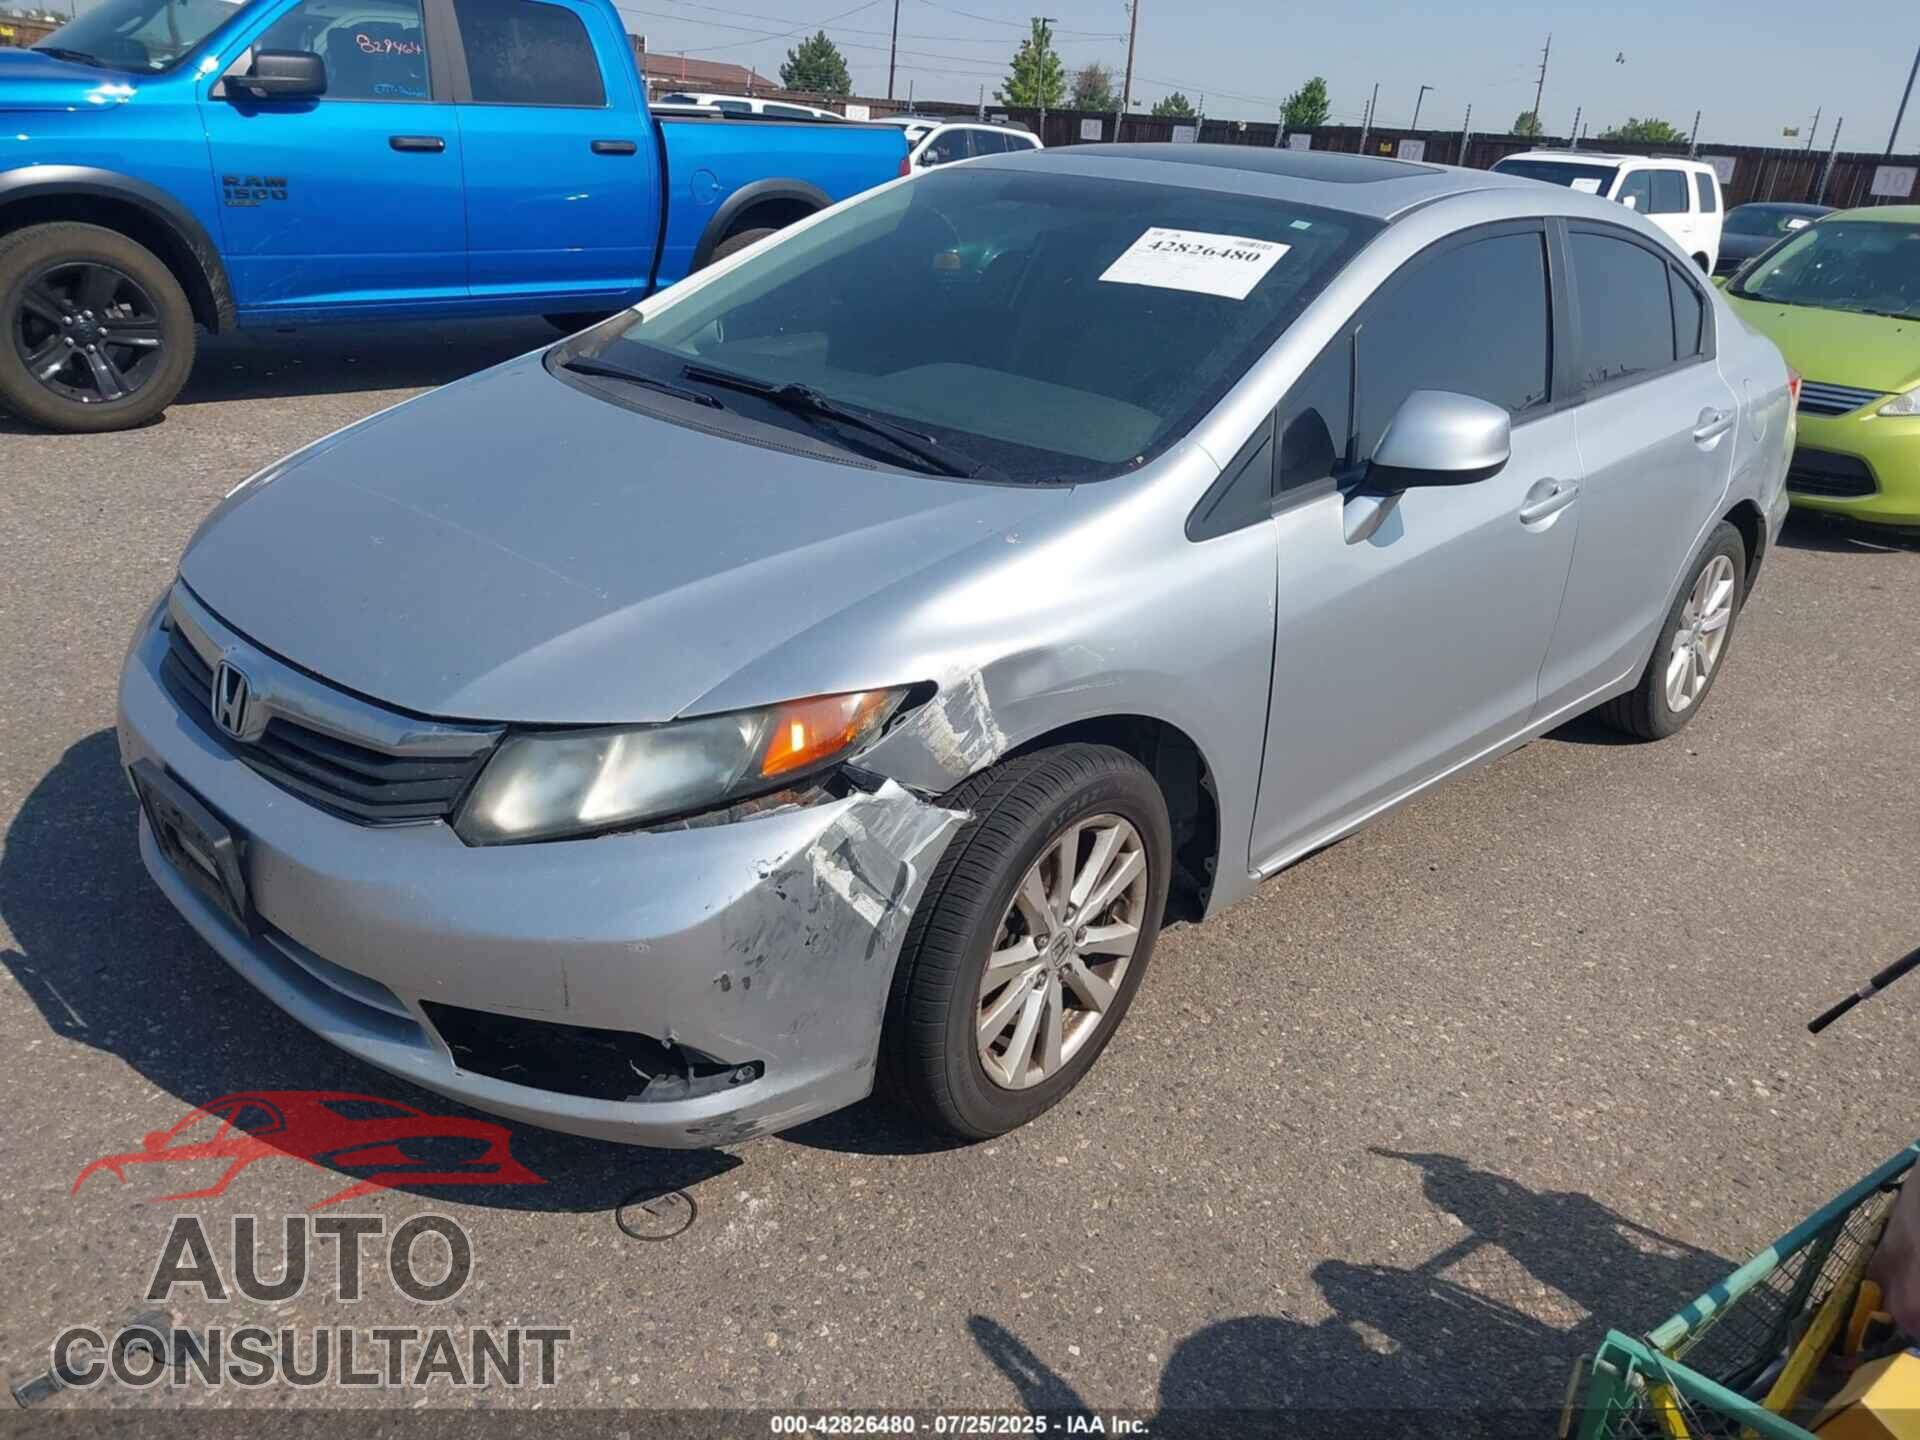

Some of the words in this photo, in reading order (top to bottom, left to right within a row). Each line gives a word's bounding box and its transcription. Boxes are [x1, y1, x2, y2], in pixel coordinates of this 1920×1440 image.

[222, 176, 288, 186] RAM
[223, 188, 288, 200] 1500
[1148, 240, 1262, 263] 42826480
